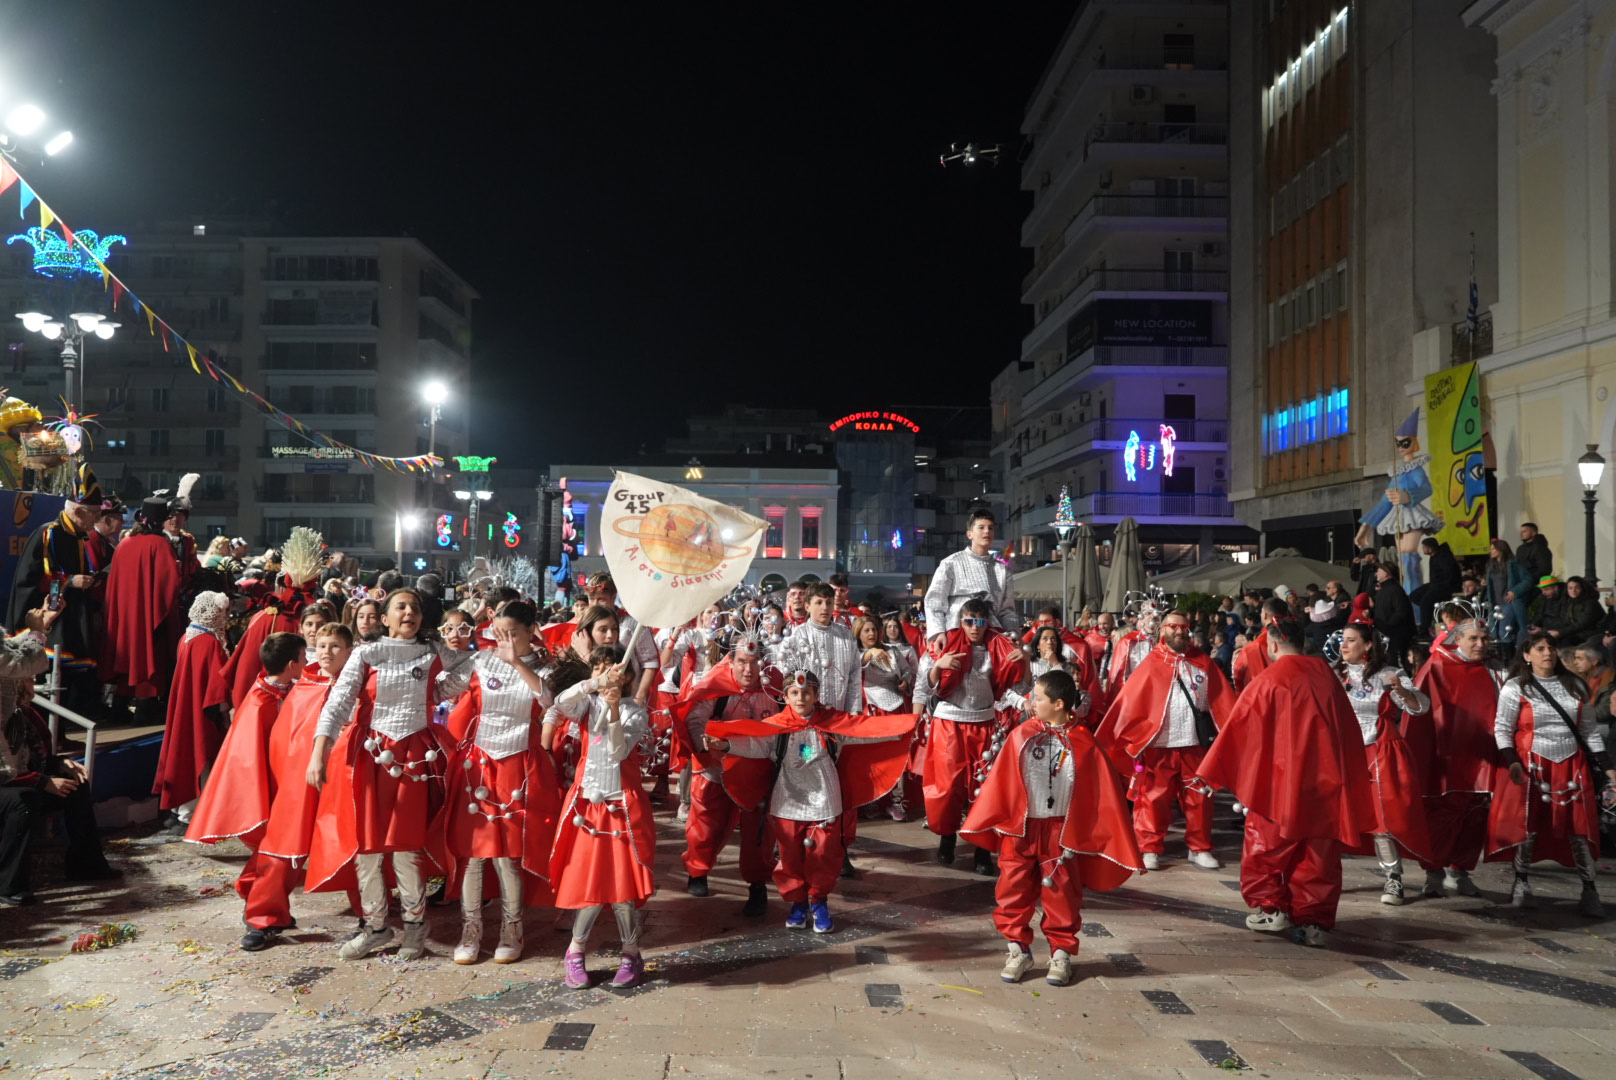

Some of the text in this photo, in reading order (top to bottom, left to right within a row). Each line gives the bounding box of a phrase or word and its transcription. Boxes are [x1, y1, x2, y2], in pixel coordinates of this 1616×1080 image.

[1114, 320, 1196, 328] NEW LOCATION
[829, 411, 920, 432] ΕΜΠΟΡΙΚΟ ΚΕΝΤΡΟ
[855, 422, 894, 431] ΚΟΛΛΑ
[614, 489, 665, 503] Group
[625, 500, 651, 514] 45
